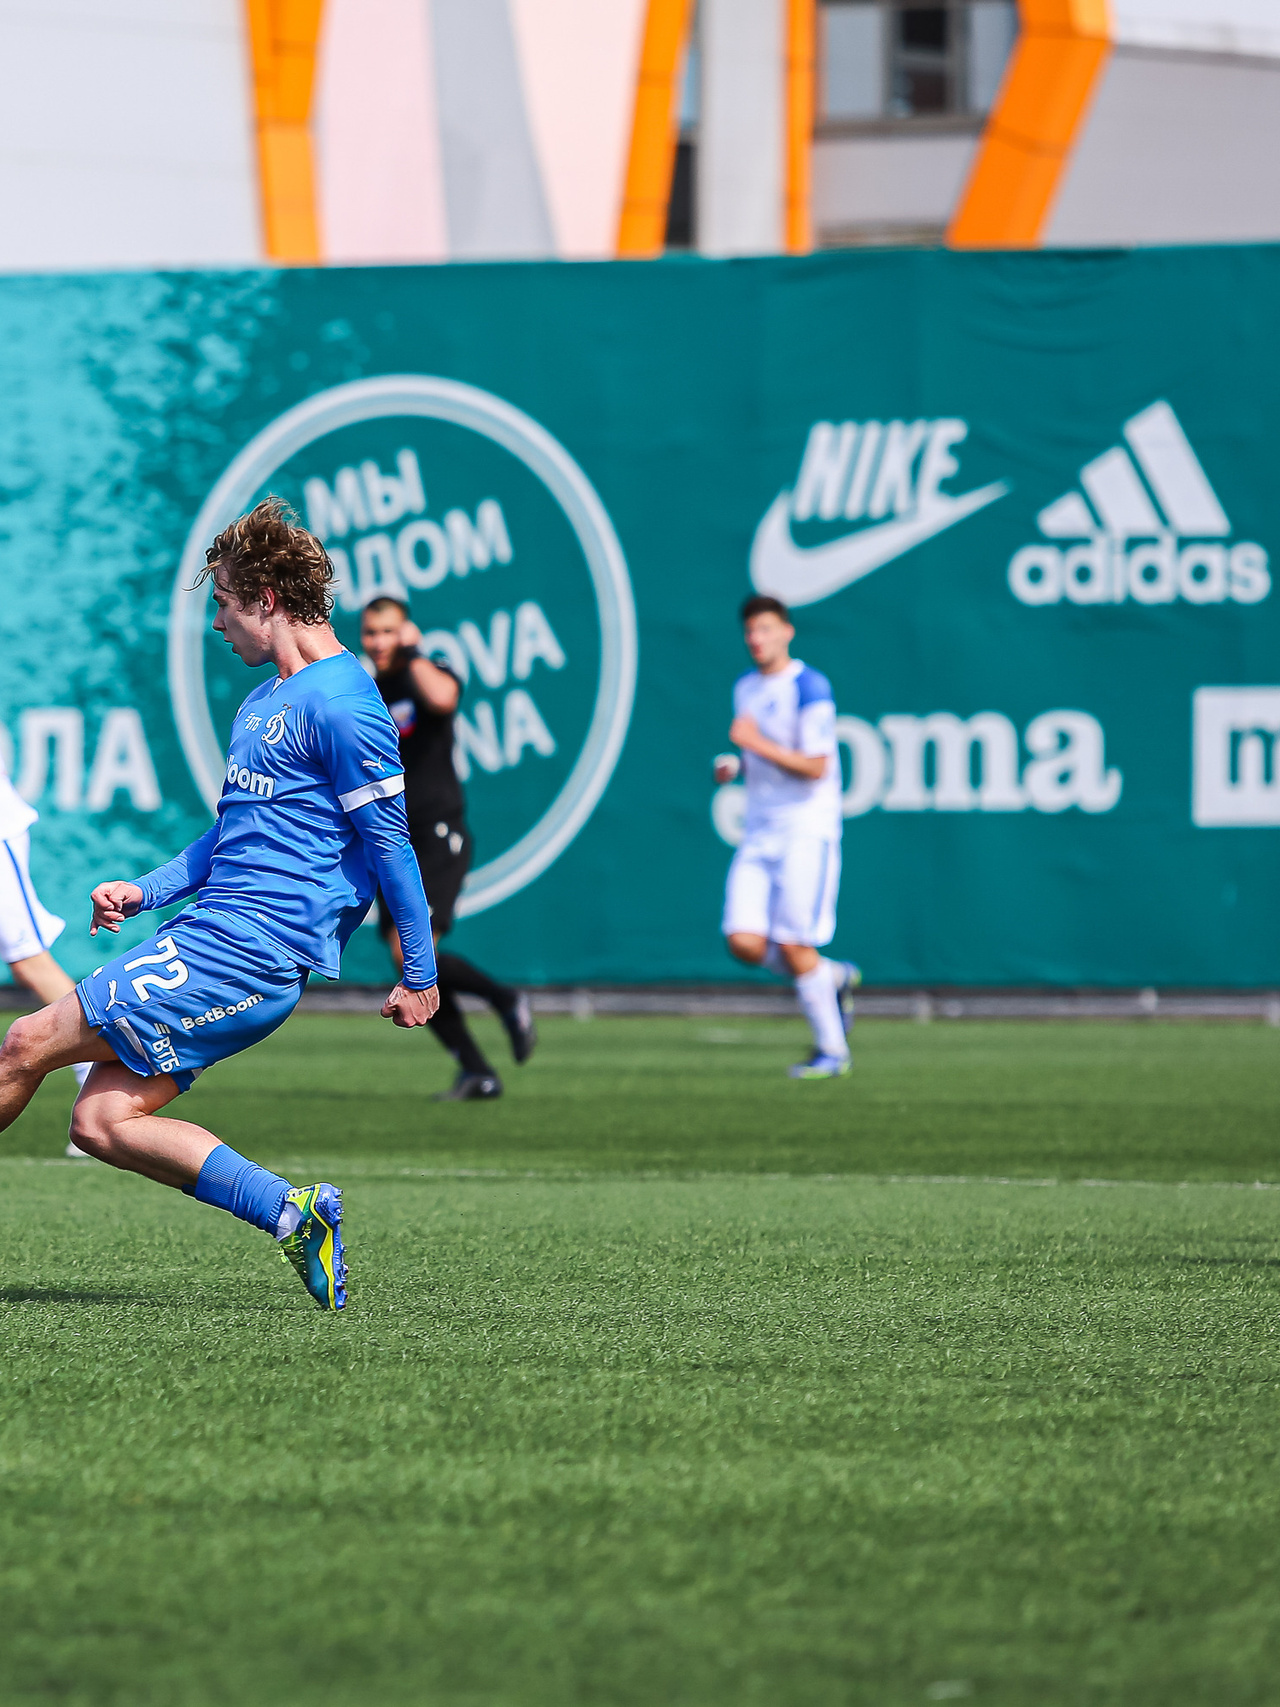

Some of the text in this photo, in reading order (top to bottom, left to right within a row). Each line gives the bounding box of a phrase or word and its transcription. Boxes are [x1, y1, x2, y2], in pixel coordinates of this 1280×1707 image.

[304, 448, 426, 542] МЫ
[795, 419, 968, 520] NIKE
[1008, 532, 1272, 606] adidas
[415, 600, 567, 688] OVA
[712, 708, 1123, 848] oma
[124, 936, 189, 1002] 72
[181, 993, 264, 1030] BetBoom
[151, 1036, 182, 1074] ВТБ
